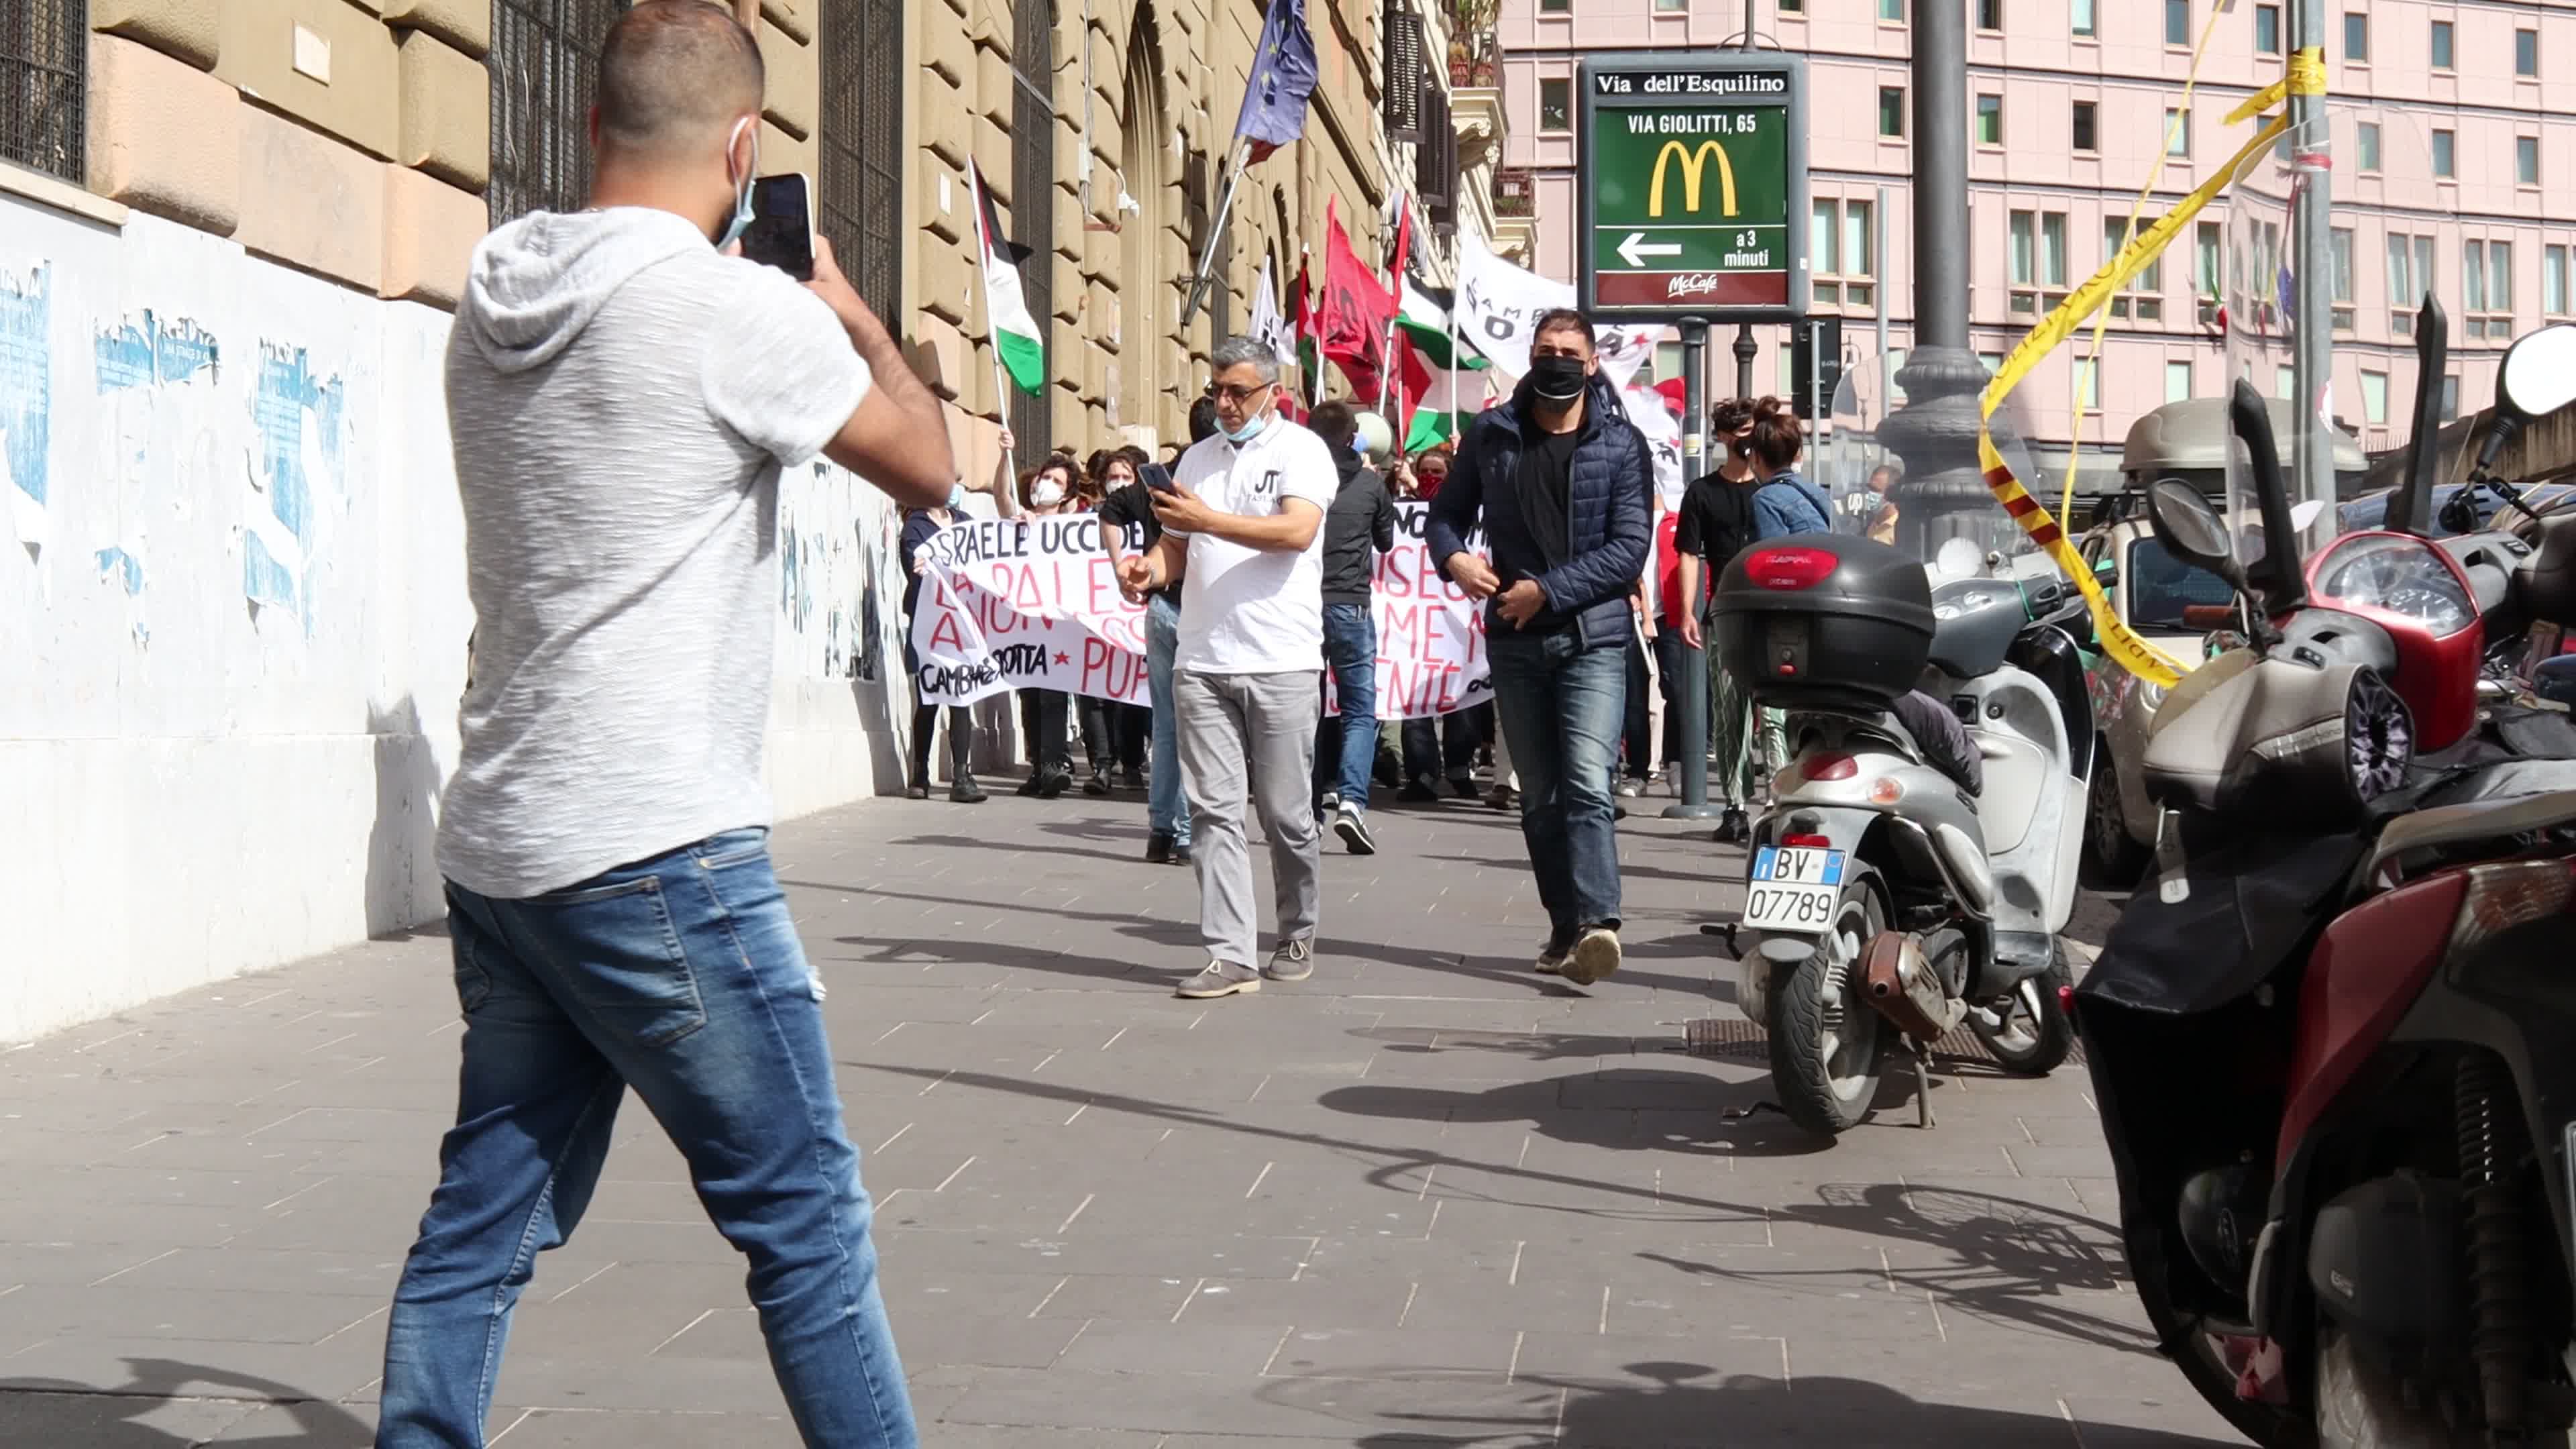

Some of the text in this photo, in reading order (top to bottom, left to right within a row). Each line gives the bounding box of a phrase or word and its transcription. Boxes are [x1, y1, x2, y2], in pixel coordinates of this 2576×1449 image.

[1598, 74, 1784, 95] Via dell'Esquilino
[1627, 114, 1756, 135] VIA GIOLITTI, 65
[1736, 229, 1756, 248] a 3
[1723, 249, 1769, 266] minuti
[1775, 849, 1810, 880] BV
[1749, 890, 1831, 923] 07789
